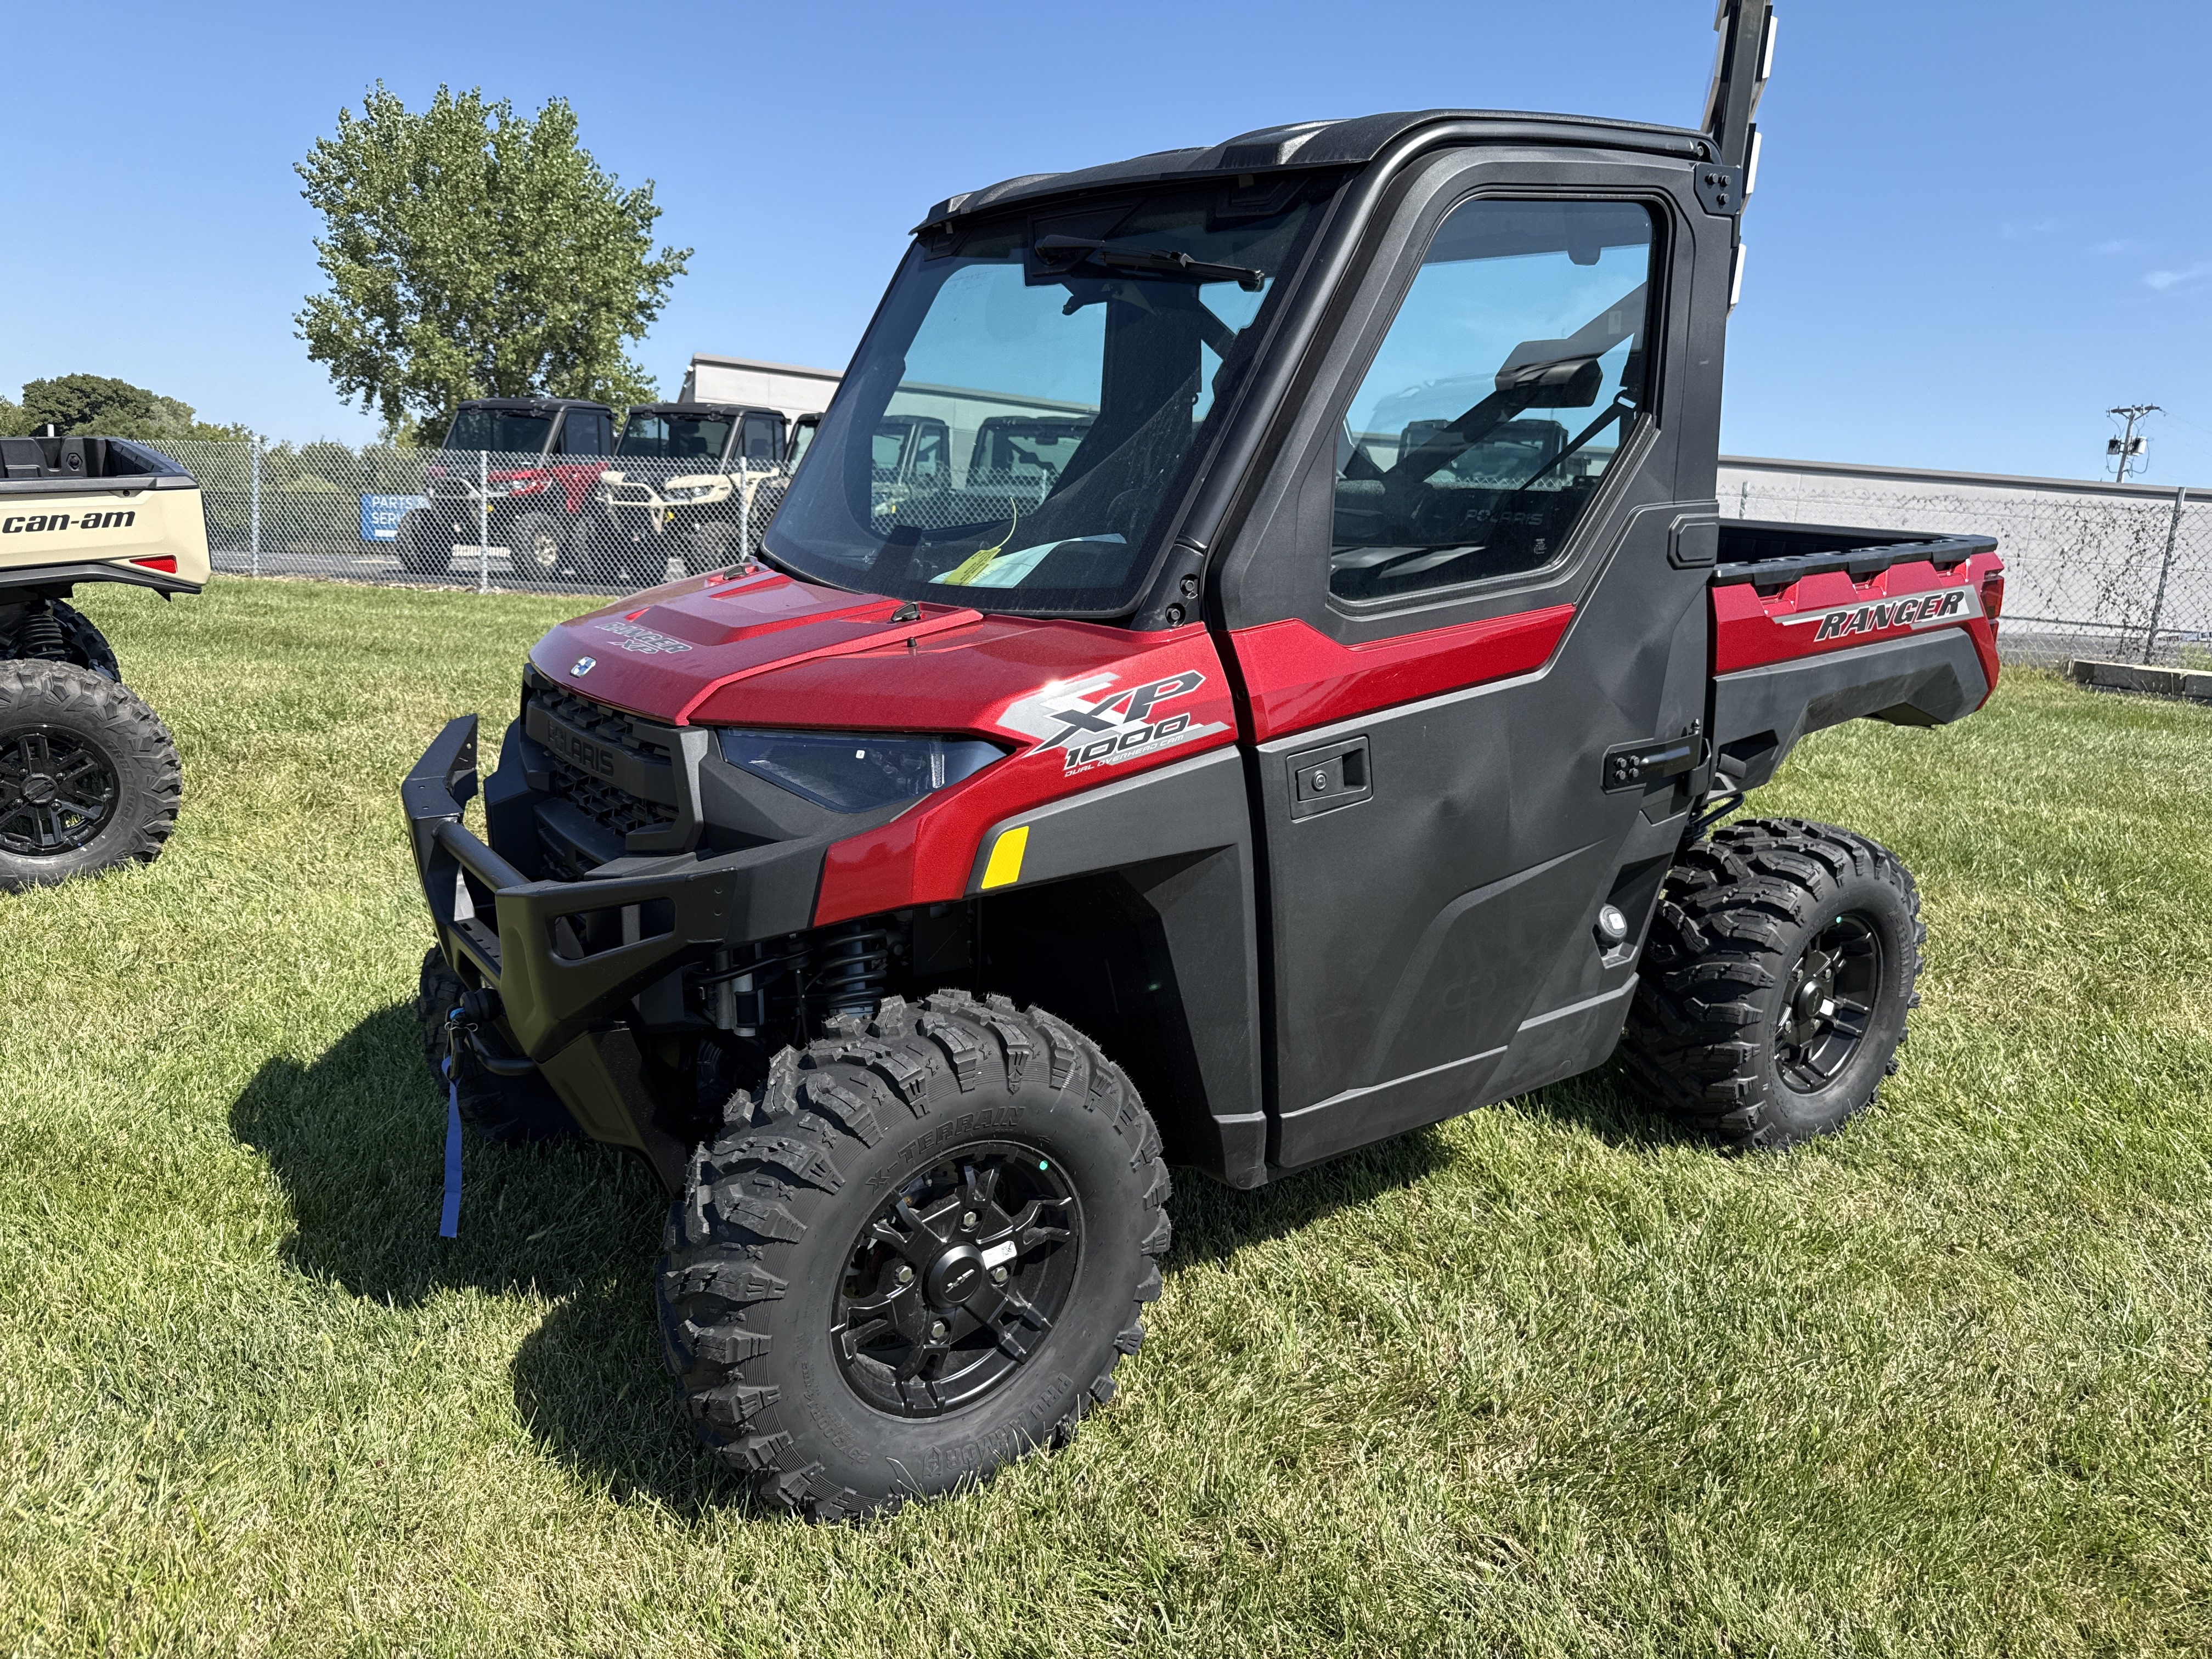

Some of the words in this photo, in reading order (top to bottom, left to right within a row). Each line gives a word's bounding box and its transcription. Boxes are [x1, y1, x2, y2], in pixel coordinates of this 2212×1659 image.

[2, 511, 136, 534] can-am
[373, 496, 413, 510] PARTS
[594, 622, 693, 653] RANGER
[1813, 590, 1966, 642] RANGER
[607, 639, 659, 654] XP
[1020, 669, 1206, 759] XP
[548, 719, 614, 778] POLARIS
[1063, 712, 1191, 771] 1000
[1064, 764, 1095, 778] DUAL
[1097, 743, 1158, 768] OVERHEAD
[1159, 734, 1184, 747] CAM
[865, 1105, 1026, 1195] X-TERRAIN
[1030, 1372, 1074, 1420] PRO
[946, 1412, 1029, 1470] ARMOR
